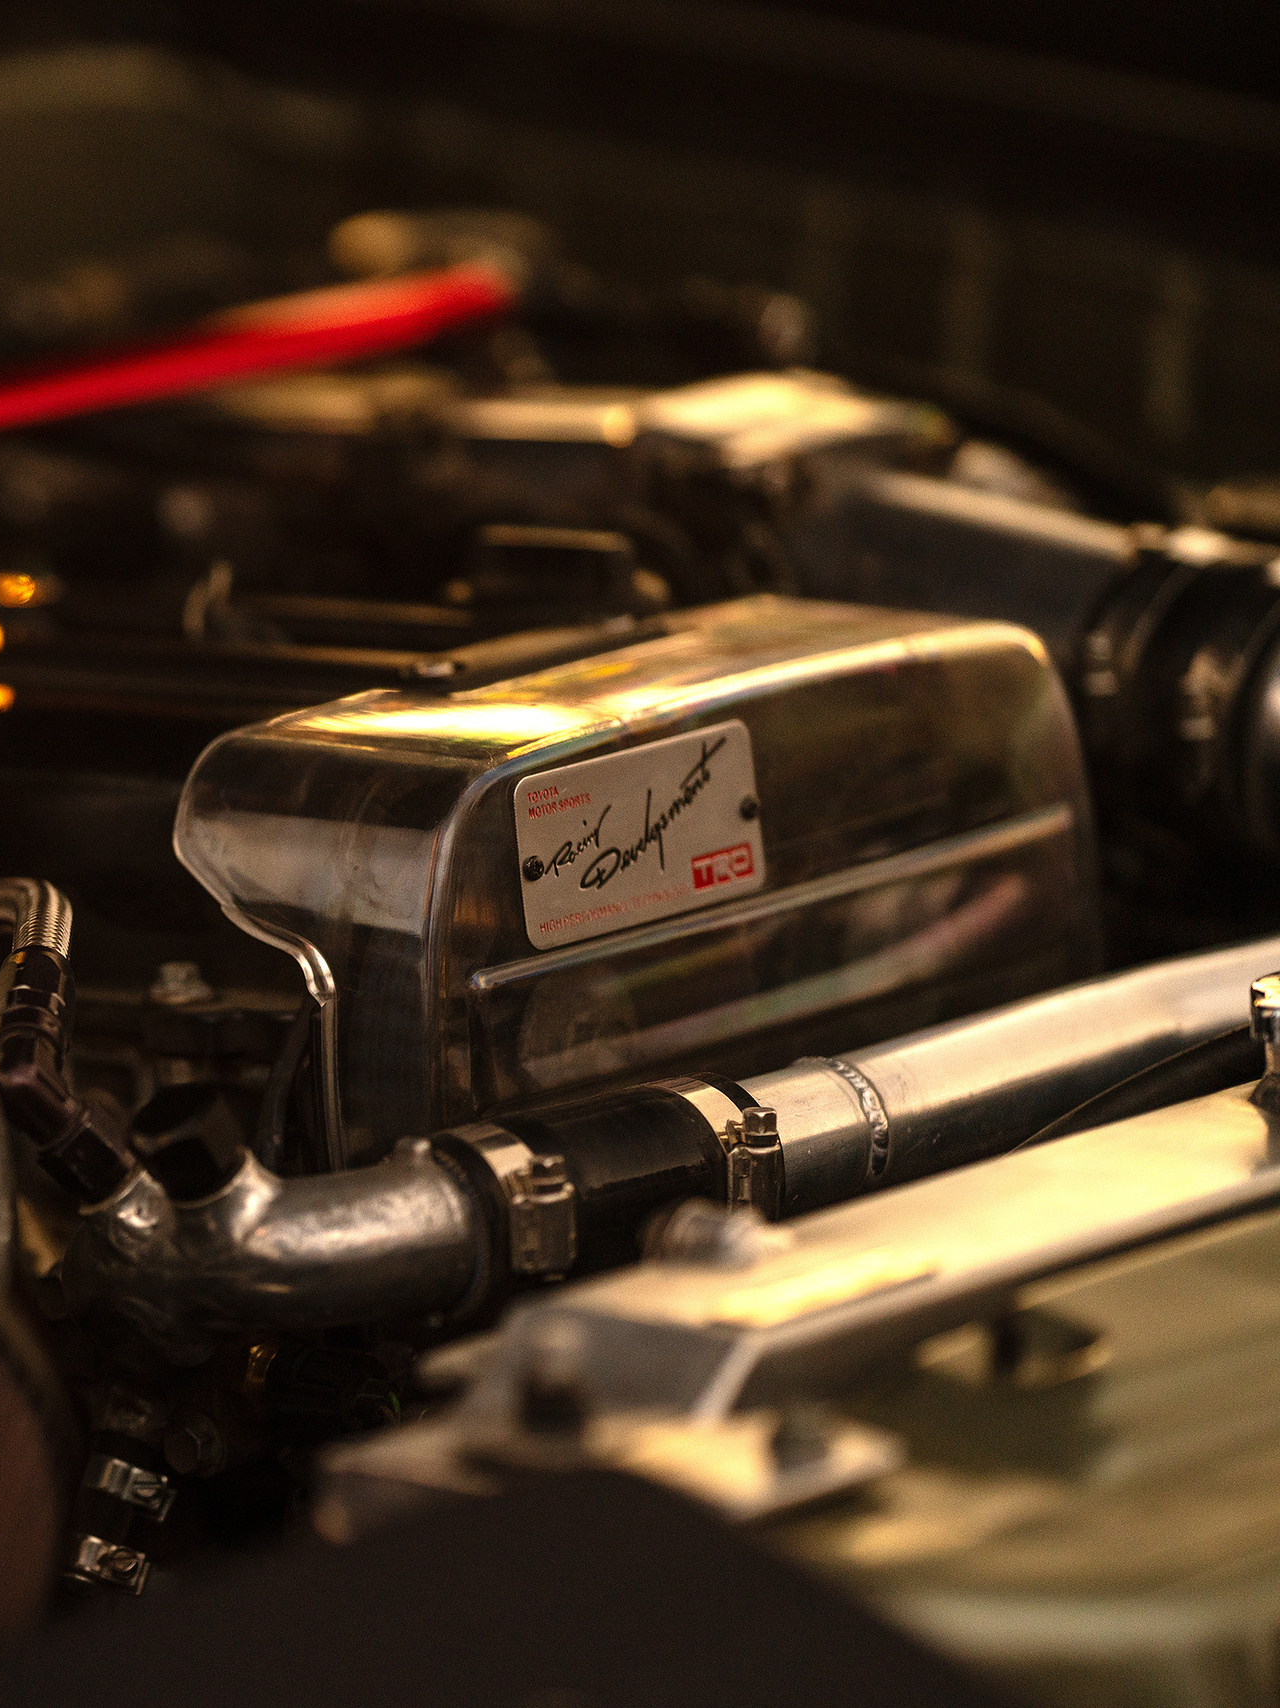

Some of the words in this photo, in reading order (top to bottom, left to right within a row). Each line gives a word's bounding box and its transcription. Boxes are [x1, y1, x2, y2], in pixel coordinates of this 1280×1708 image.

[527, 786, 559, 803] TOYOTA
[528, 802, 558, 819] MOTOR
[558, 793, 591, 812] SPORTS
[580, 736, 726, 889] Development
[545, 804, 611, 877] Racing
[692, 843, 754, 888] TRD
[539, 918, 562, 934] HIGH
